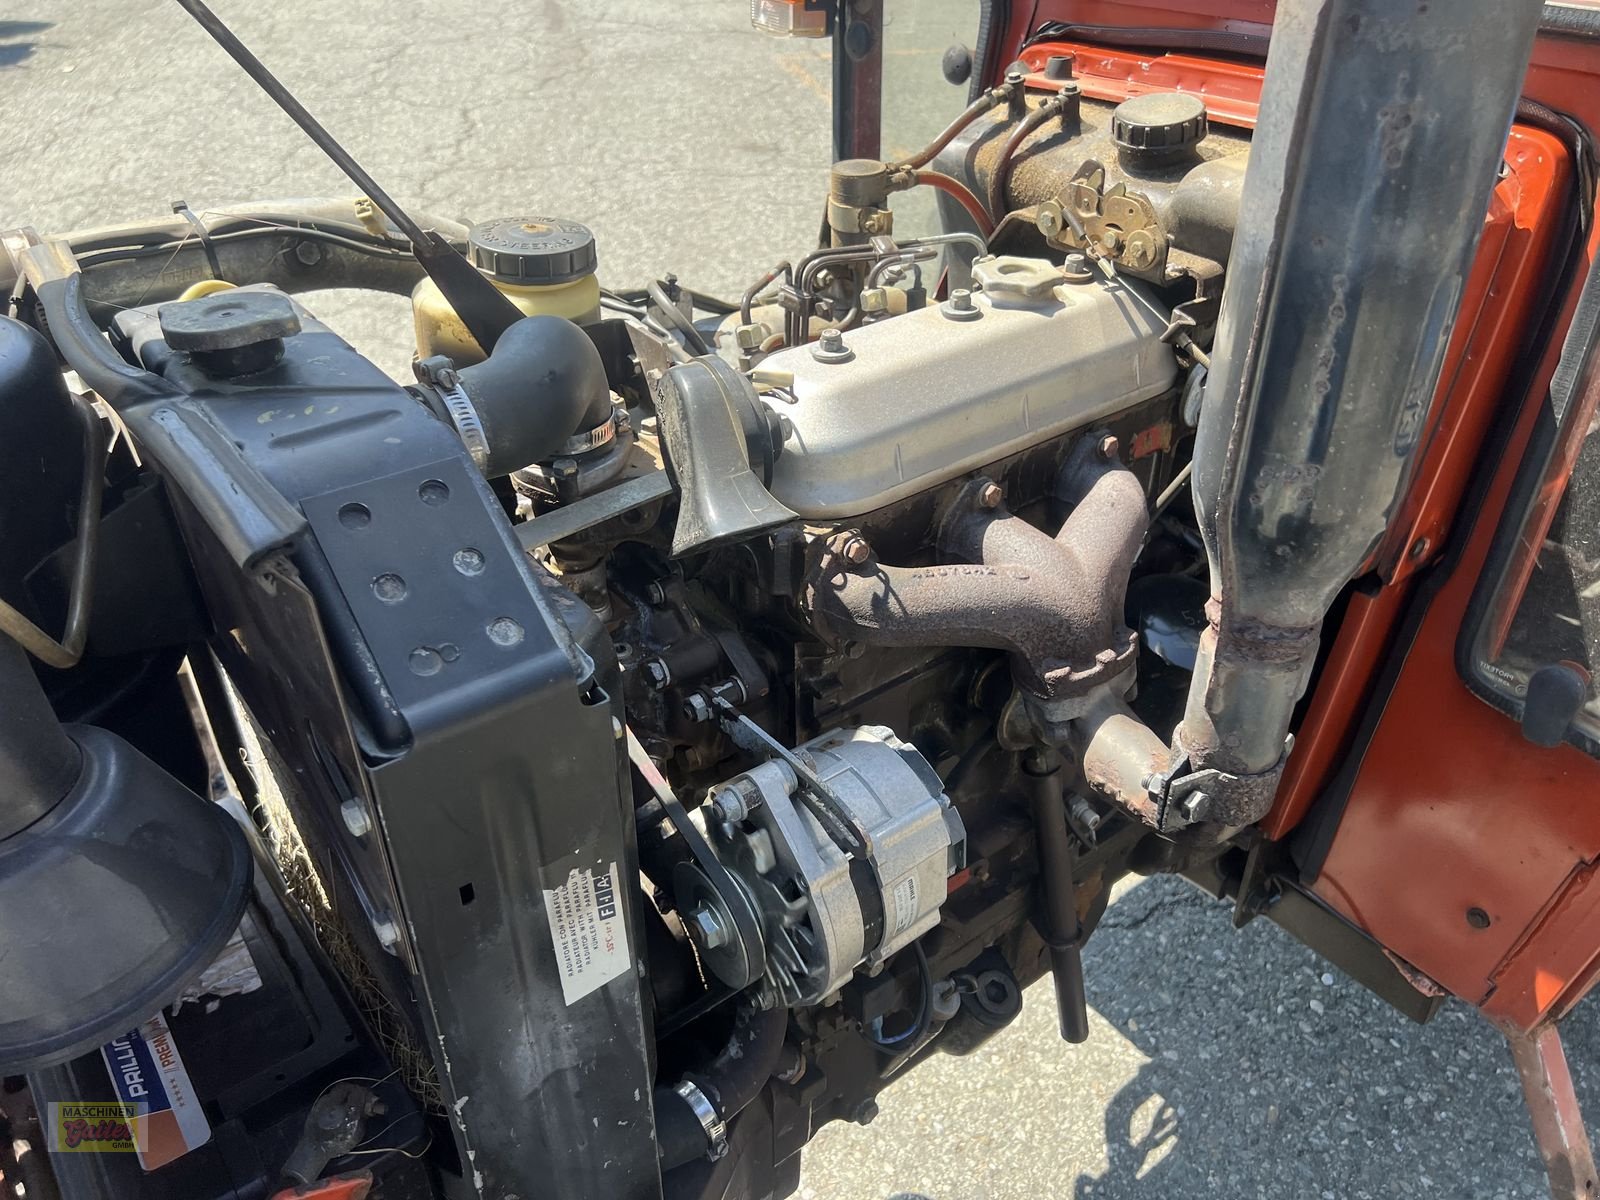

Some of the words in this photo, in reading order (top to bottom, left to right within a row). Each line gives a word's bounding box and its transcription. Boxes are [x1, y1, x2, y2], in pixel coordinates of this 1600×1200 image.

[552, 892, 563, 923] PARAFLU
[571, 881, 581, 912] PARAFLU
[596, 876, 615, 918] FIA
[568, 920, 578, 937] AVEC
[577, 914, 586, 932] WITH
[586, 912, 595, 926] MIT
[580, 934, 592, 966] RADIATOR
[588, 926, 599, 950] KÜHLER
[562, 941, 573, 977] RADIATORE
[571, 938, 583, 973] RADIATEUR
